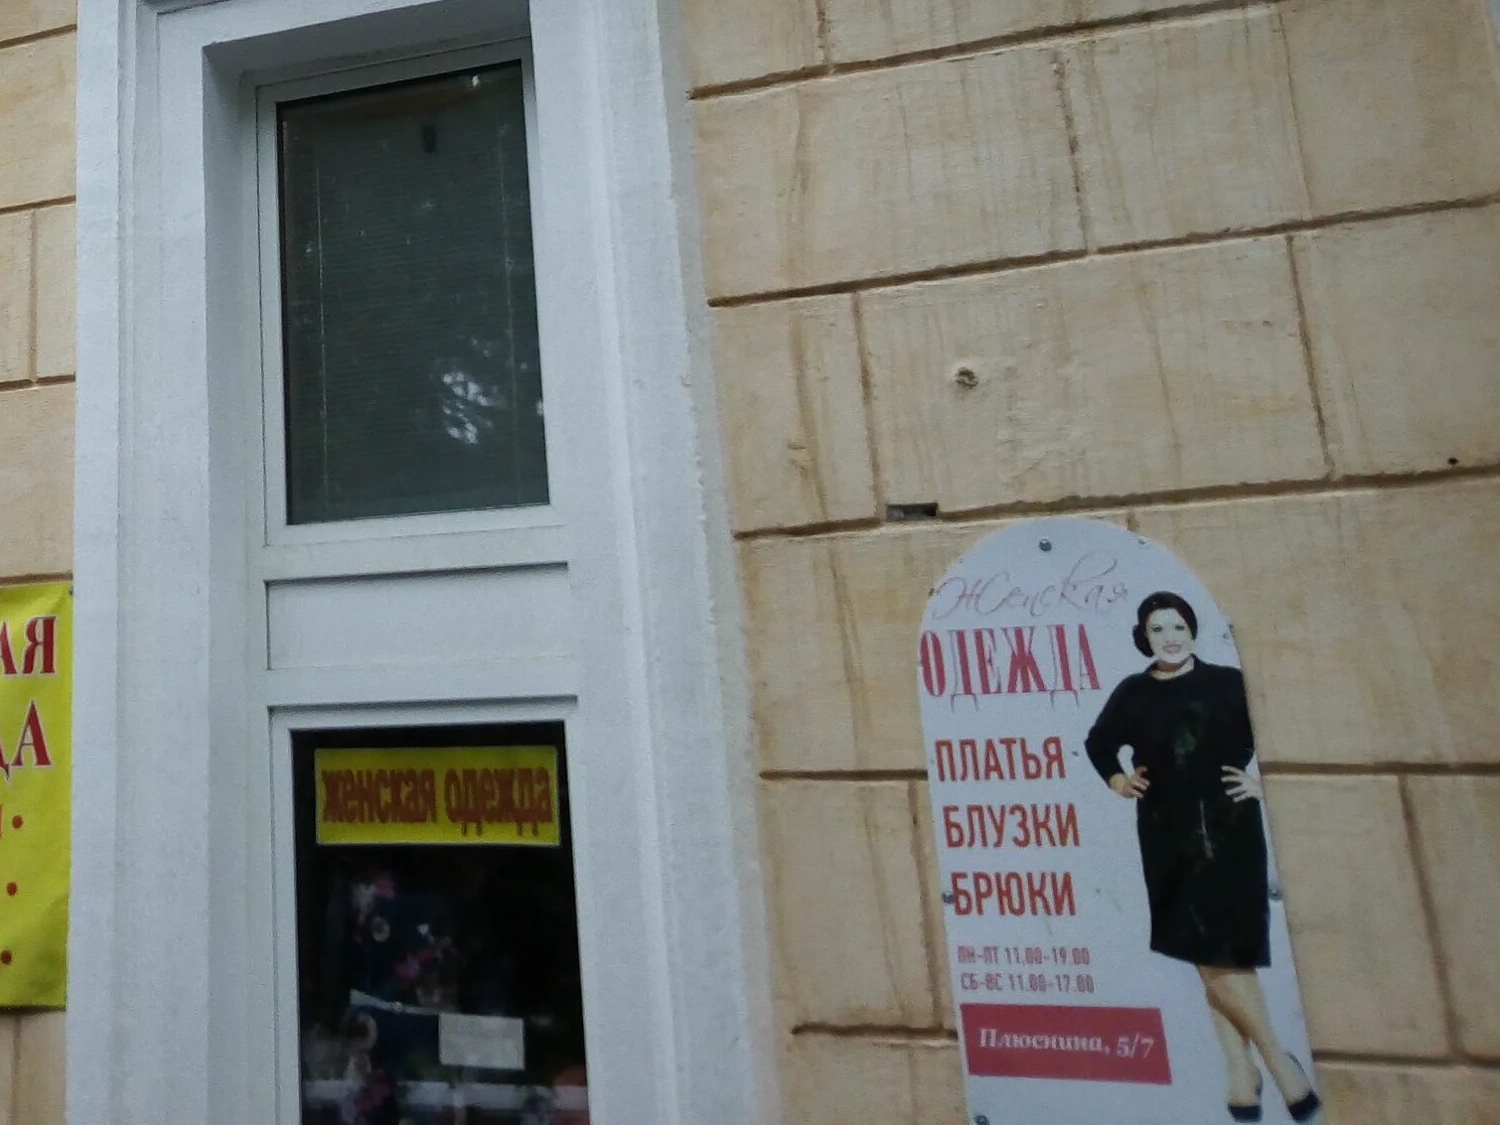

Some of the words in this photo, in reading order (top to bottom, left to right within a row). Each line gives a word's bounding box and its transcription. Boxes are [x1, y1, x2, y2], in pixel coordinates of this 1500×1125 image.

[919, 624, 1103, 713] ОДЕЖДА
[935, 735, 1067, 782] ПЛАТЬЯ
[943, 803, 1081, 849] БЛУЗКИ
[950, 870, 1077, 917] БРЮКИ
[1116, 1033, 1155, 1059] 5/7
